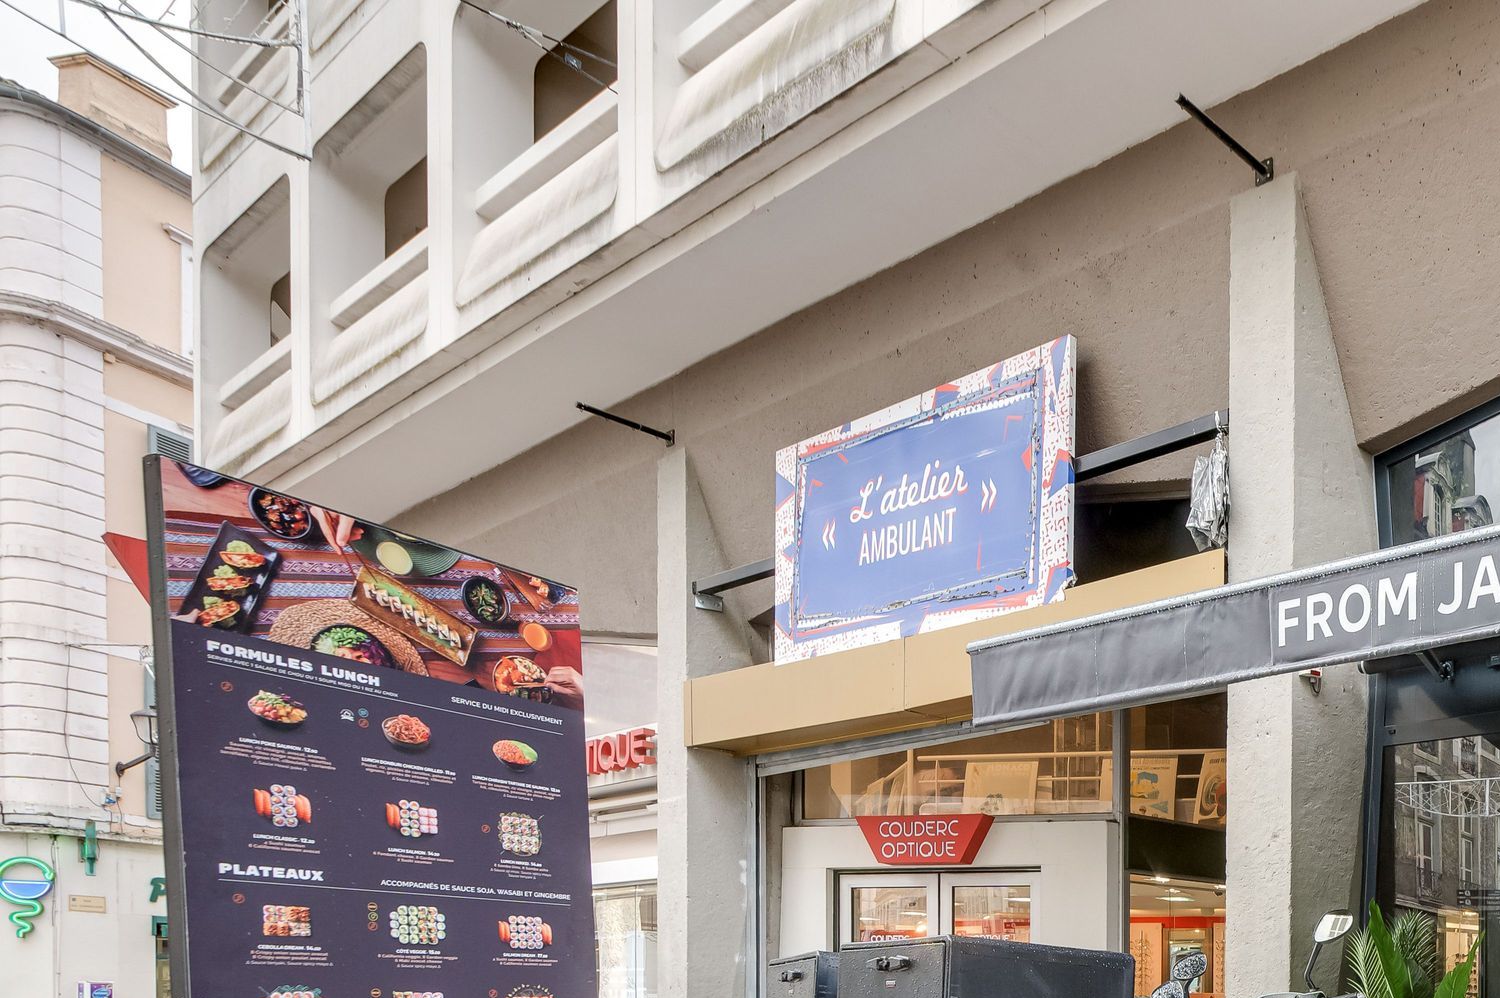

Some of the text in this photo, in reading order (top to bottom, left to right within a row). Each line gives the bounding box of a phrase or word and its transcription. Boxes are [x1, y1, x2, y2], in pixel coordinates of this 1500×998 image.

[850, 459, 968, 524] L'atelier
[858, 507, 956, 566] AMBULANT
[1277, 572, 1418, 648] FROM
[206, 638, 380, 687] FORMULES LUNCH
[233, 659, 249, 667] AVEC
[255, 663, 277, 673] SALADE
[287, 670, 303, 678] CHOU
[451, 695, 562, 726] SERVICE DU MIDI EXCLUSIVEMENT
[879, 819, 959, 838] COUDERC
[881, 841, 956, 859] OPTIQUE
[218, 861, 324, 882] PLATEAUX
[380, 877, 438, 890] ACCOMPAGNÉS
[440, 882, 450, 891] DE
[451, 884, 474, 893] SAUCE
[496, 888, 523, 898] WASABI
[524, 891, 532, 899] ET
